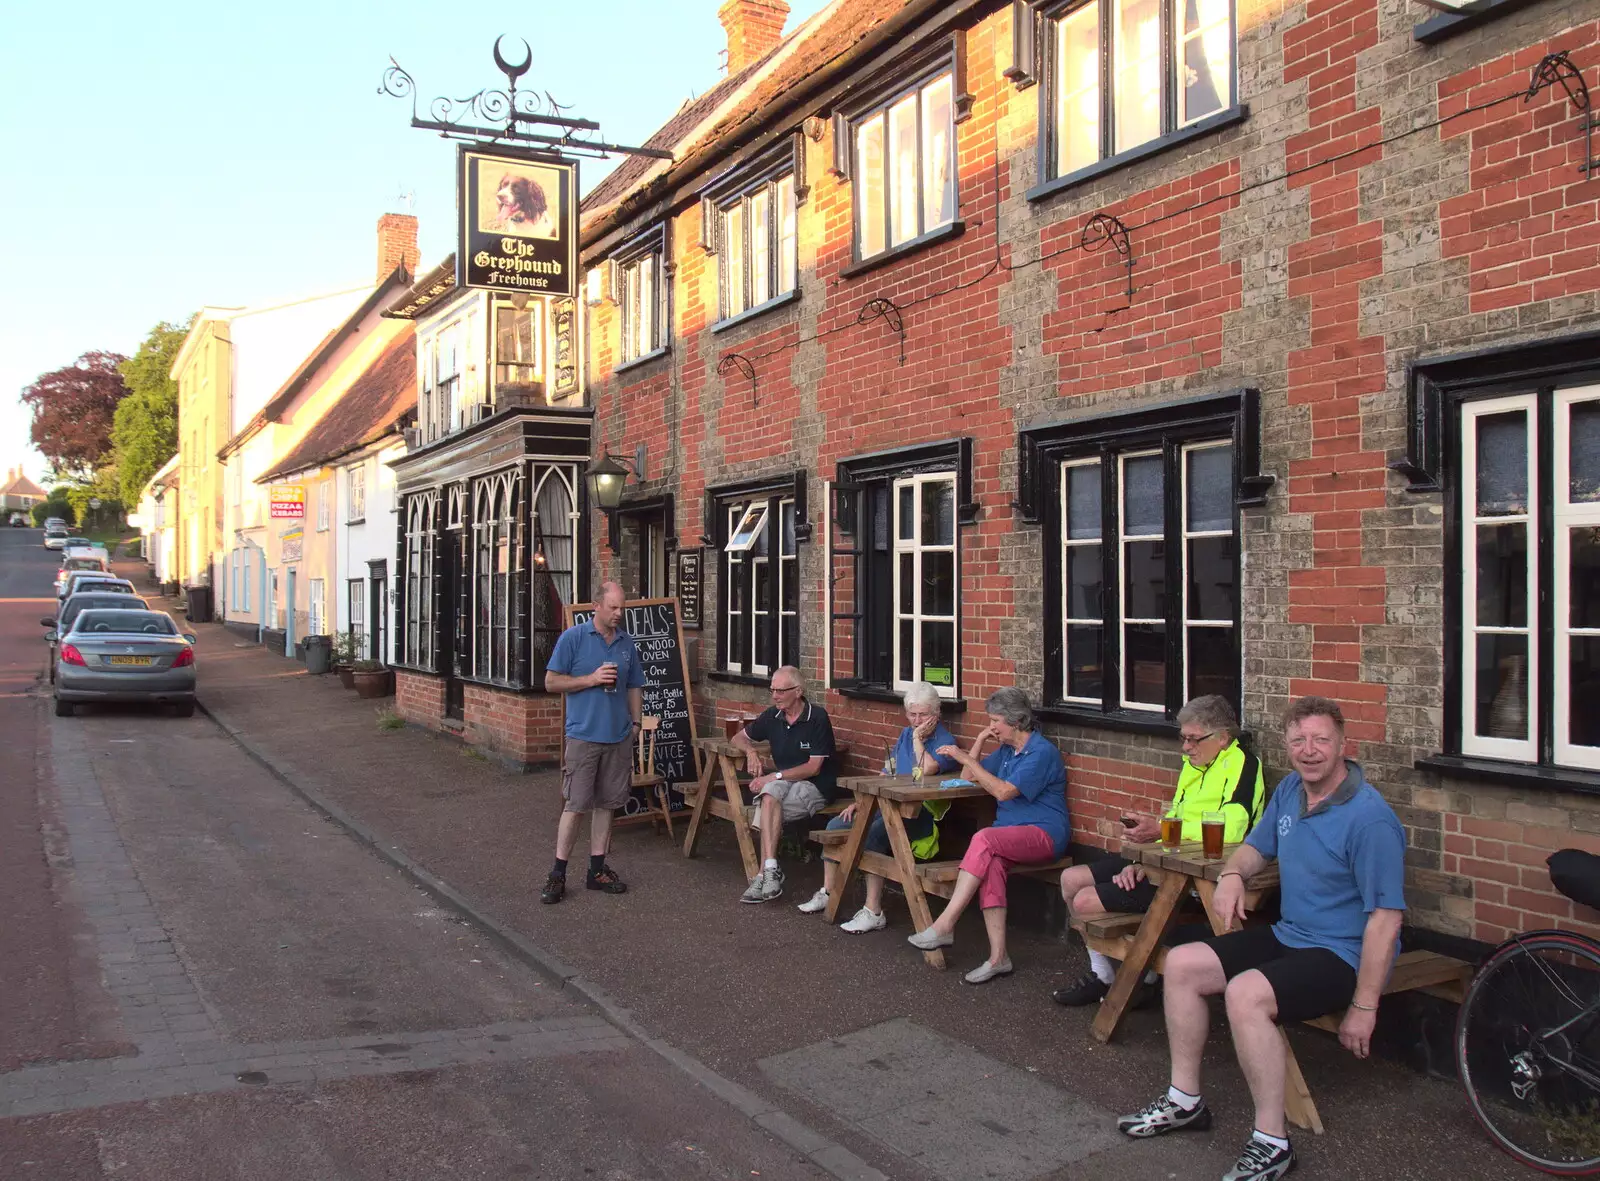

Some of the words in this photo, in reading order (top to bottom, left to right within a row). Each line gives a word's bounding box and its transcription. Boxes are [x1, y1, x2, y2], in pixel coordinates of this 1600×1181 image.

[501, 238, 535, 257] The
[474, 251, 562, 275] Greyhound
[487, 271, 548, 288] Freehouse
[647, 639, 676, 651] WOOD
[642, 651, 670, 662] OVEN
[650, 665, 667, 676] One
[652, 701, 664, 711] For
[664, 710, 688, 720] Pizzas
[662, 721, 675, 729] For
[657, 730, 677, 739] Pizza
[656, 761, 685, 778] SAT
